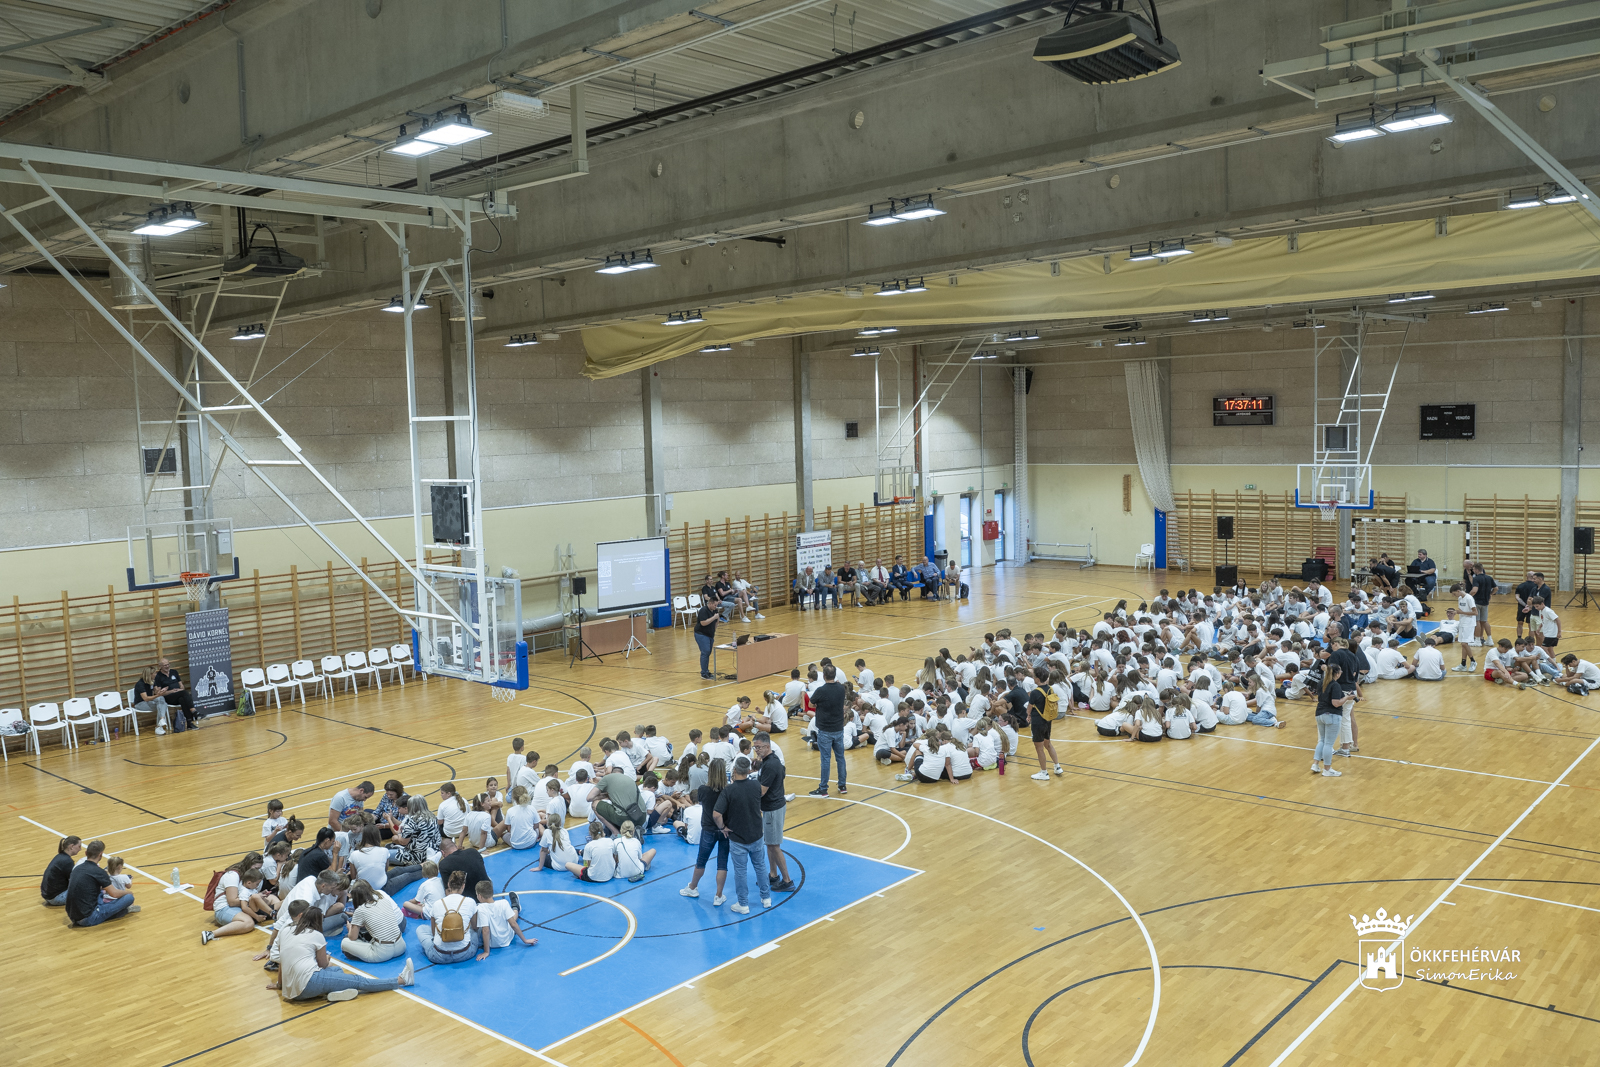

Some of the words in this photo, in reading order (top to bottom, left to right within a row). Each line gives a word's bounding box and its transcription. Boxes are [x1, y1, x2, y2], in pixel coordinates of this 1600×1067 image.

[1224, 400, 1262, 410] 17:37:11
[188, 630, 206, 640] DÁVID
[207, 627, 228, 637] KORNÉL
